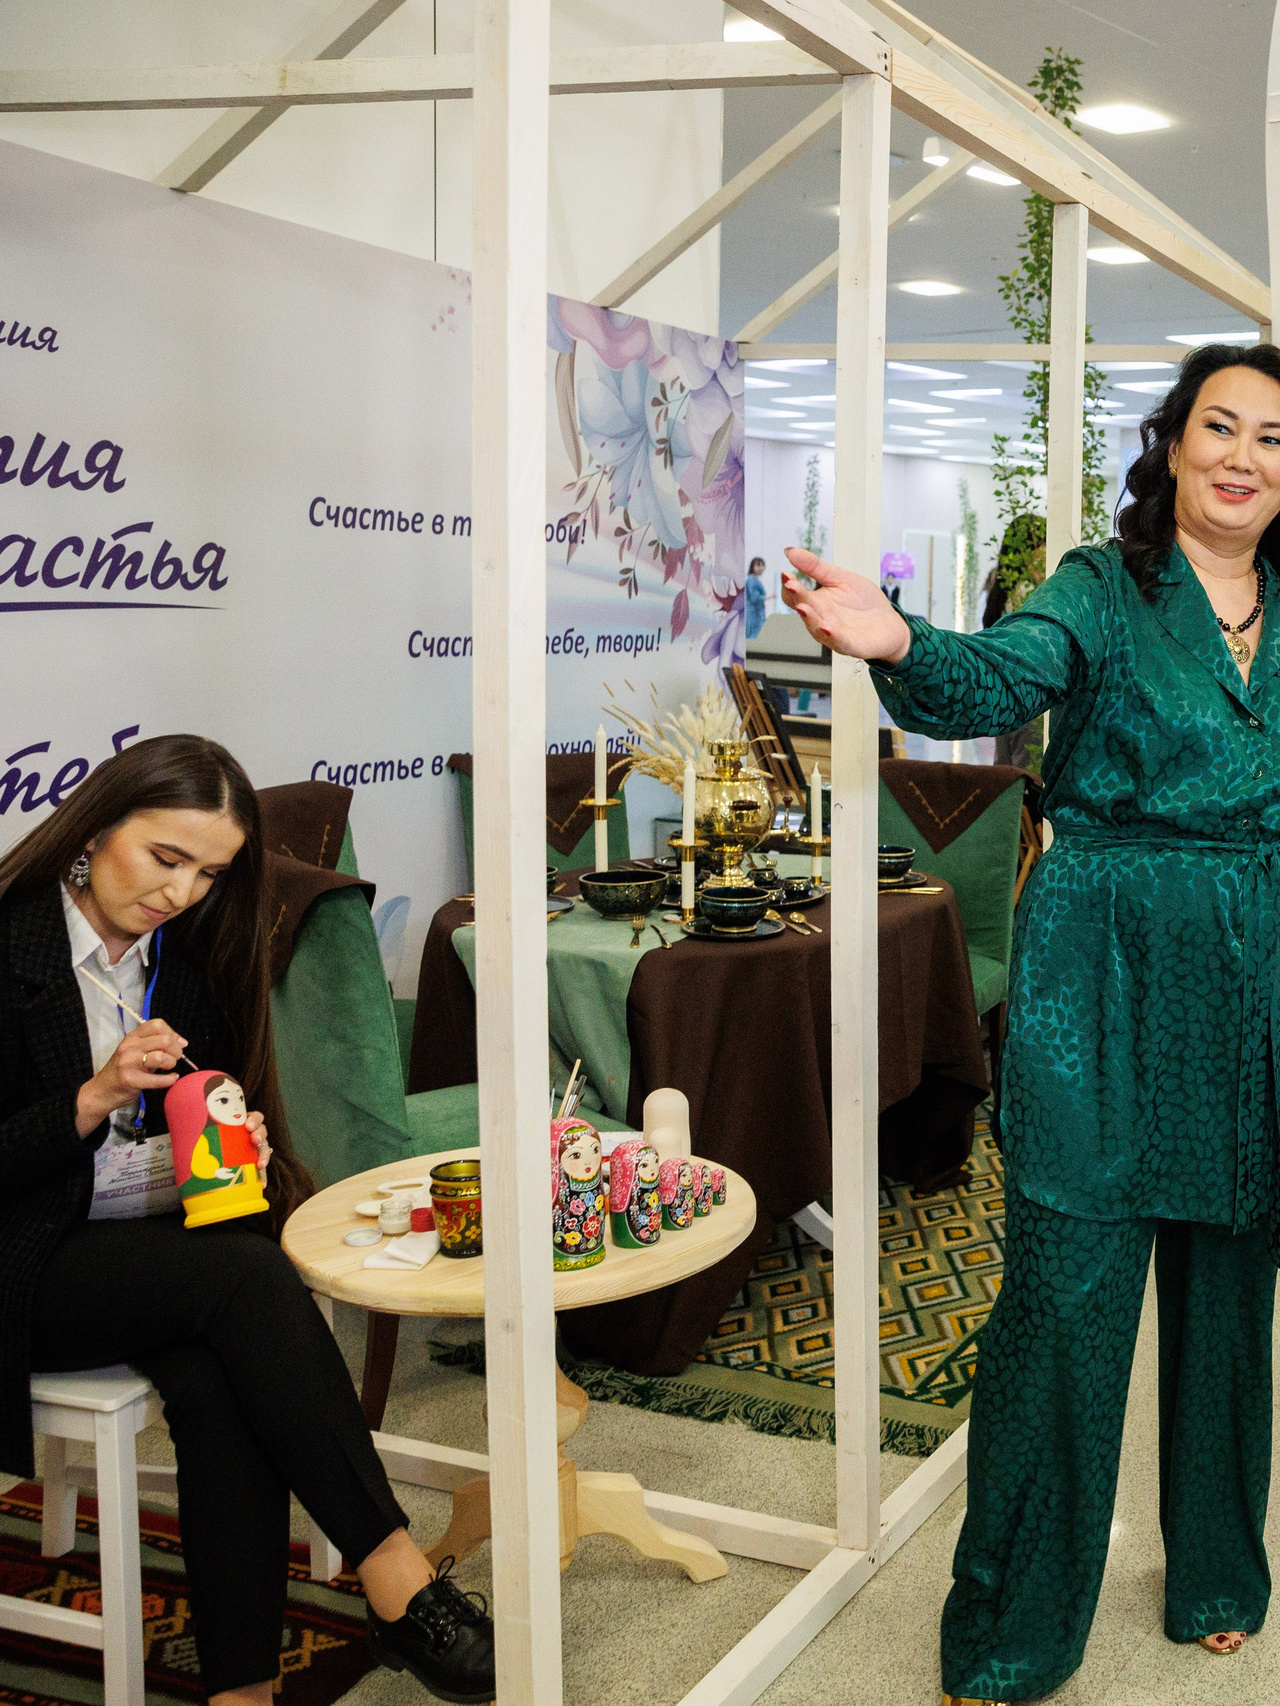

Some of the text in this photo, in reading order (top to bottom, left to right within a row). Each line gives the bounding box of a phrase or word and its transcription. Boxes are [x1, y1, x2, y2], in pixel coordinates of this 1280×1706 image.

[309, 496, 424, 534] Счастье
[431, 513, 445, 535] в
[408, 630, 472, 659] Счаст
[595, 627, 662, 658] твори!
[310, 756, 424, 787] Счастье
[431, 754, 444, 776] в
[107, 1179, 174, 1197] УЧАСТНИК
